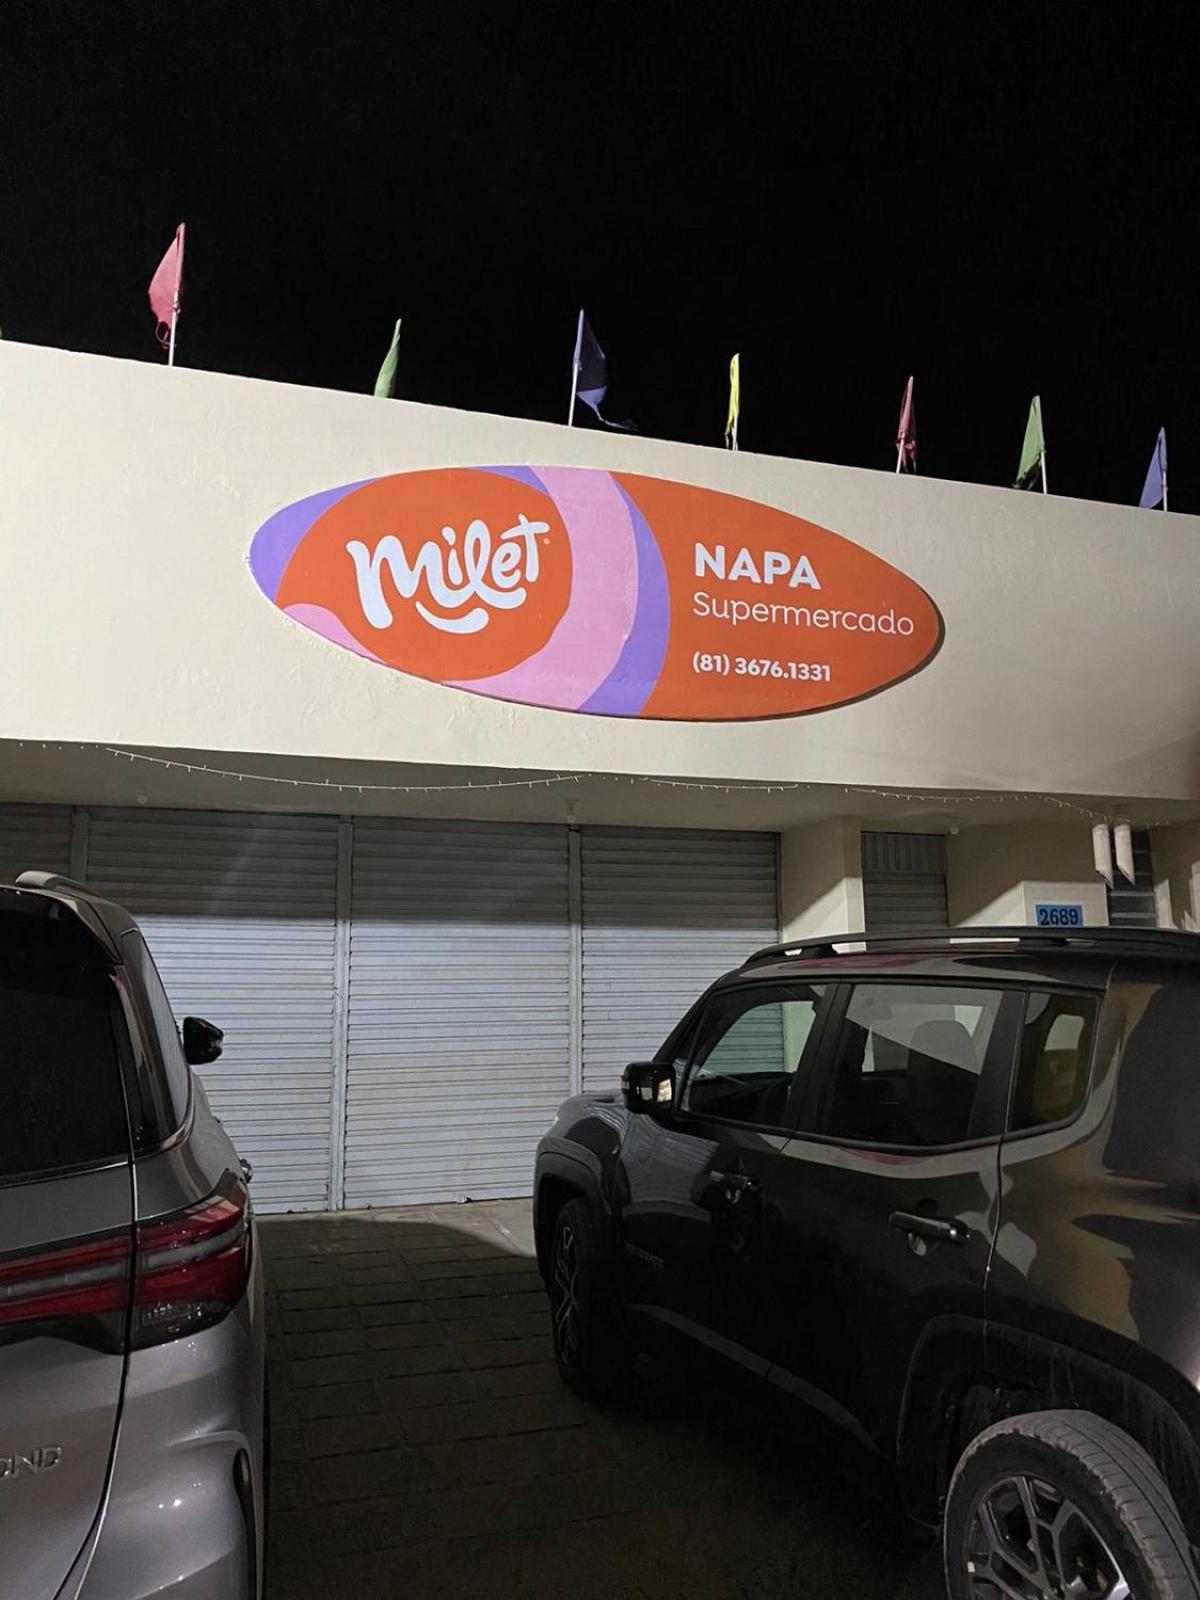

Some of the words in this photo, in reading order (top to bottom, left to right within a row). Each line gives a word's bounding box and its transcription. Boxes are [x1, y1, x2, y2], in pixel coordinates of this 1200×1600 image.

[694, 542, 822, 591] NAPA
[692, 591, 915, 636] Supermercado
[692, 651, 731, 676] (81)
[734, 656, 831, 682] 3676.1331
[1038, 908, 1079, 926] 2689
